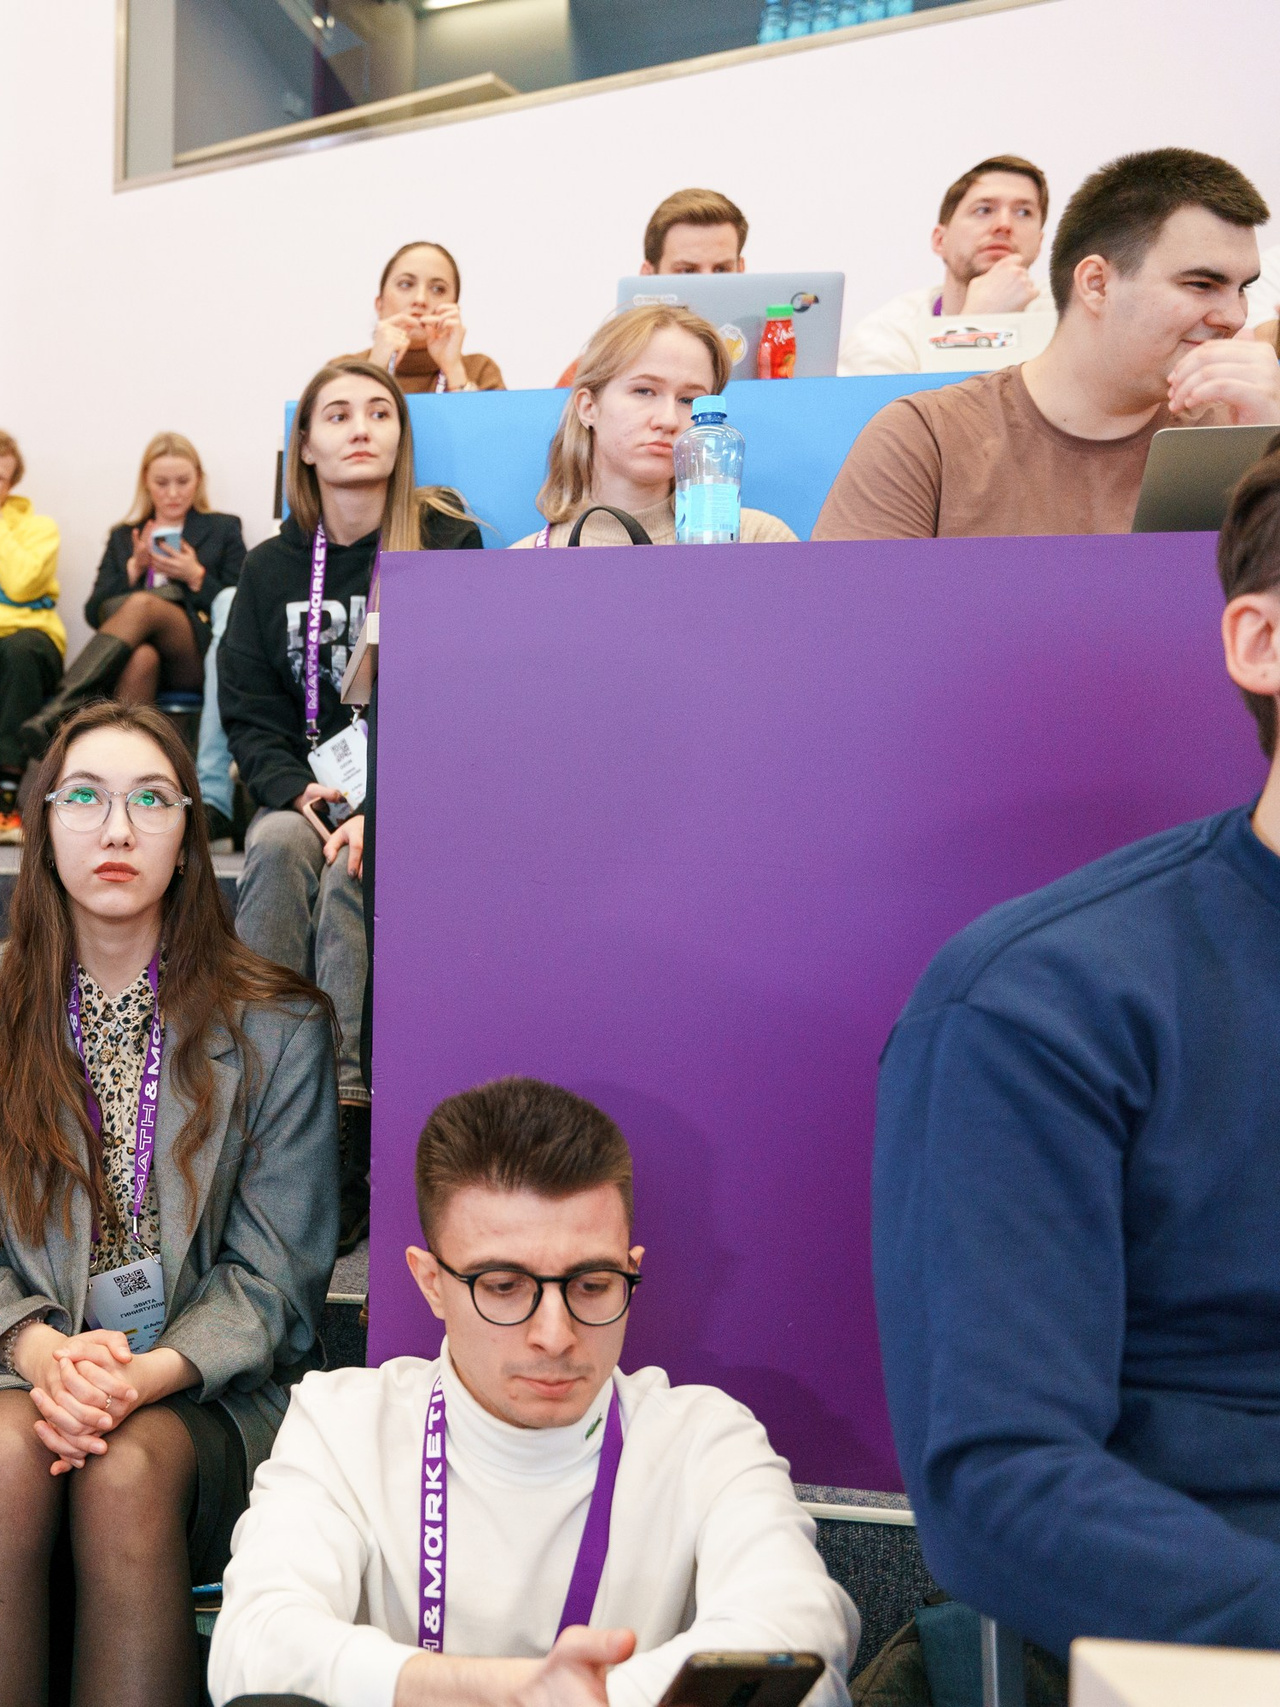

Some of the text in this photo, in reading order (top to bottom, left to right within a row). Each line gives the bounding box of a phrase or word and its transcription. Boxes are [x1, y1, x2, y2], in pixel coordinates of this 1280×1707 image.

[309, 629, 319, 643] &
[308, 645, 317, 709] MATH
[144, 1080, 158, 1100] &
[135, 1104, 156, 1203] MATH
[120, 1301, 165, 1318] ГИНИЯТУЛЛИ
[133, 1298, 157, 1309] ЭВИТА
[423, 1604, 441, 1633] &
